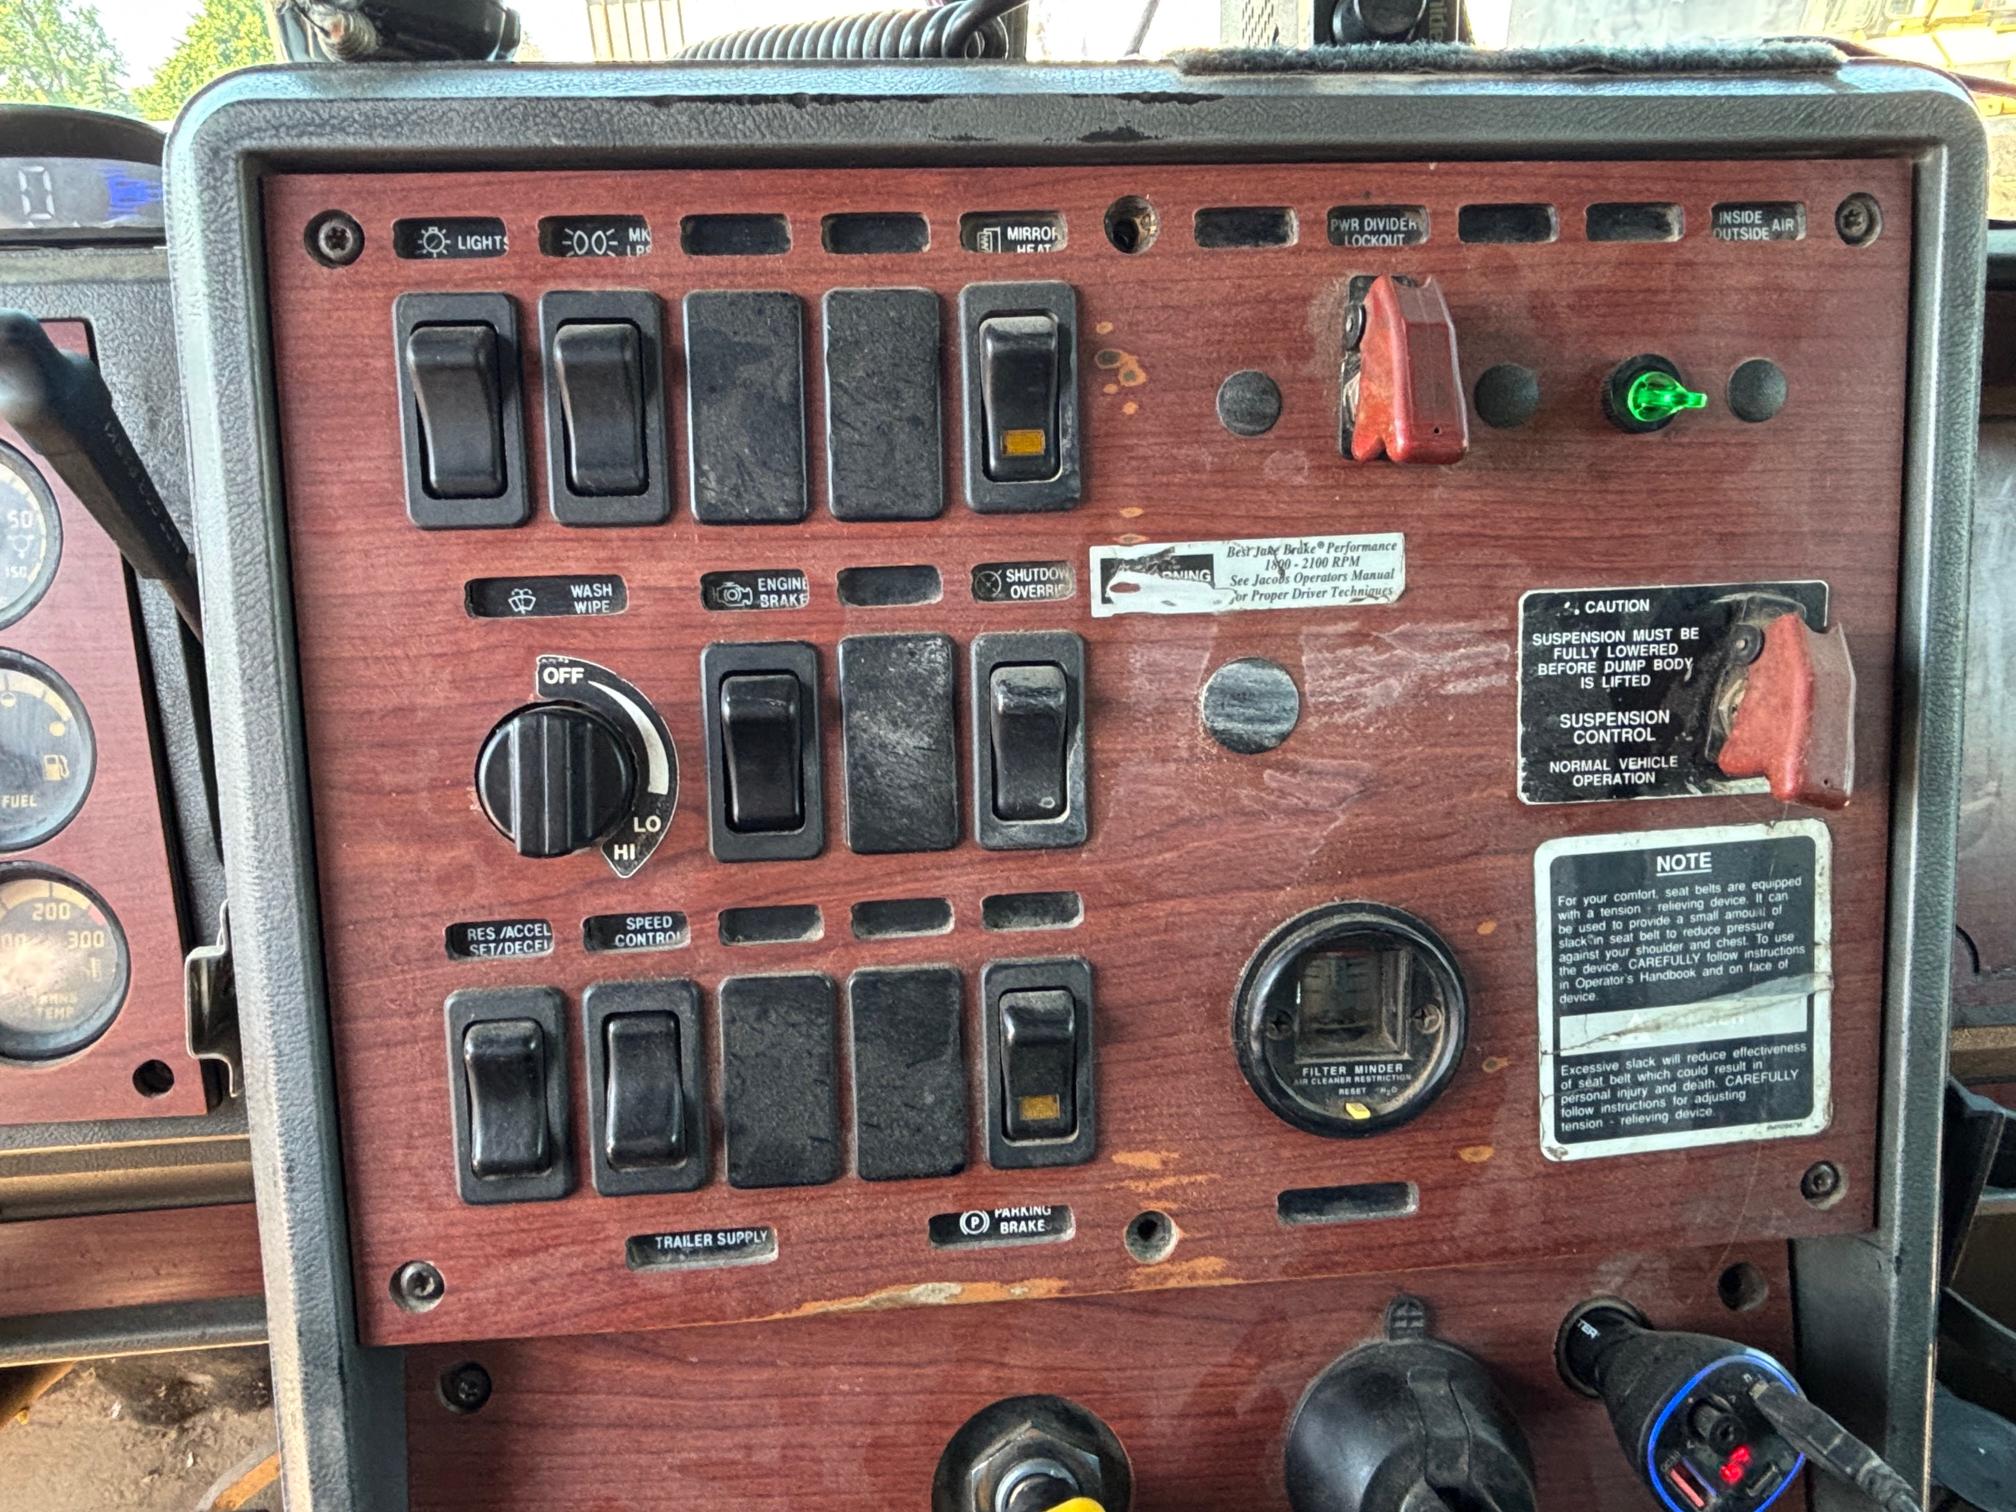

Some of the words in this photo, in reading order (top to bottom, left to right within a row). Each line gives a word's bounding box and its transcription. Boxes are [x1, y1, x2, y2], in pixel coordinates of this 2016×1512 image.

[1330, 218, 1359, 231] PWR
[1364, 218, 1416, 231] DIVIDER
[1720, 211, 1762, 224] INSIDE
[1772, 218, 1794, 231] AIR
[1345, 234, 1405, 246] LOCKOUT
[1713, 228, 1769, 240] OUTSIDE
[1227, 547, 1250, 558] Best
[1327, 542, 1397, 554] Performance
[1265, 558, 1291, 571] 1800
[1302, 557, 1328, 569] 2100
[1332, 556, 1360, 568] RPM
[758, 577, 808, 591] ENGINE
[1230, 574, 1250, 587] See
[1252, 574, 1290, 587] Jacobs
[1294, 572, 1347, 586] Operators
[1352, 568, 1395, 580] Manual
[571, 584, 612, 598] WASH
[1252, 589, 1289, 604] Proper
[1292, 587, 1327, 599] Driver
[574, 600, 610, 614] WIPE
[760, 593, 808, 608] BRAKE
[1585, 599, 1650, 614] CAUTION
[1532, 630, 1625, 646] SUSPENSION
[1633, 628, 1673, 642] MUST
[1680, 627, 1699, 640] BE
[1554, 647, 1599, 660] FULLY
[1607, 643, 1678, 658] LOWERED
[1538, 662, 1596, 675] BEFORE
[1604, 660, 1646, 673] DUMP
[1653, 657, 1693, 671] BODY
[542, 667, 584, 684] OFF
[1581, 677, 1594, 689] IS
[1602, 674, 1651, 688] LIFTED
[1560, 710, 1670, 728] SUSPENSION
[1573, 727, 1656, 744] CONTROL
[1550, 759, 1610, 773] NORMAL
[1619, 756, 1678, 770] VEHICLE
[1573, 772, 1656, 787] OPERATION
[2, 794, 37, 807] FUEL
[634, 816, 661, 833] LO
[614, 844, 636, 860] HI
[1656, 852, 1712, 872] NOTE
[1557, 896, 1578, 907] For
[1582, 894, 1608, 908] your
[1664, 886, 1690, 898] seat
[1694, 883, 1722, 895] belts
[1727, 882, 1746, 893] are
[1751, 876, 1802, 891] equipped
[32, 902, 71, 921] 200
[1557, 909, 1581, 921] with
[1586, 909, 1595, 919] a
[1600, 905, 1642, 918] tension
[1657, 899, 1705, 912] relieving
[1710, 896, 1749, 908] device.
[1755, 892, 1763, 904] It
[1768, 892, 1790, 903] can
[626, 916, 672, 930] SPEED
[1558, 923, 1574, 935] be
[1578, 920, 1607, 933] used
[1612, 920, 1624, 931] to
[1628, 915, 1672, 931] provide
[1676, 915, 1684, 925] a
[1690, 910, 1719, 923] small
[1771, 904, 1783, 917] of
[68, 930, 105, 949] 300
[467, 927, 496, 941] RES
[615, 932, 680, 947] CONTROL
[1558, 936, 1587, 950] slack
[1593, 935, 1604, 946] in
[1609, 932, 1634, 945] seat
[1639, 929, 1660, 942] belt
[1666, 929, 1678, 939] to
[1682, 925, 1722, 937] reduce
[1726, 920, 1775, 936] pressure
[1558, 949, 1600, 964] against
[1604, 947, 1631, 961] your
[1635, 942, 1684, 956] shoulder
[1688, 938, 1711, 951] and
[1715, 936, 1750, 948] chest.
[1755, 933, 1770, 945] To
[1774, 932, 1795, 943] use
[1558, 966, 1577, 977] the
[1582, 962, 1623, 975] device.
[1628, 952, 1701, 970] CAREFULLY
[1706, 951, 1739, 963] follow
[1744, 945, 1806, 959] instructions
[1559, 981, 1570, 990] in
[1574, 974, 1634, 990] Operator's
[1640, 968, 1697, 983] Handbook
[1702, 964, 1724, 977] and
[1728, 964, 1744, 975] on
[1748, 961, 1773, 973] face
[1777, 958, 1789, 970] of
[1559, 992, 1600, 1006] device.
[1560, 1061, 1620, 1077] Excessive
[1625, 1056, 1656, 1070] slack
[1661, 1053, 1681, 1066] will
[1686, 1050, 1727, 1064] reduce
[1732, 1042, 1808, 1059] effectiveness
[1302, 1066, 1346, 1076] FILTER
[1354, 1063, 1403, 1074] MINDER
[1560, 1078, 1572, 1090] of
[1578, 1076, 1604, 1088] seat
[1609, 1073, 1632, 1086] belt
[1636, 1068, 1672, 1082] which
[1676, 1064, 1709, 1078] could
[1714, 1061, 1747, 1075] result
[1752, 1060, 1763, 1070] in
[1311, 1076, 1351, 1085] CLEANER
[1354, 1074, 1411, 1083] RESTRICTION
[1560, 1088, 1612, 1106] personal
[1616, 1086, 1649, 1100] injury
[1654, 1082, 1677, 1095] and
[1724, 1069, 1800, 1087] CAREFULLY
[1339, 1087, 1366, 1095] RESET
[1560, 1106, 1595, 1118] follow
[1600, 1098, 1667, 1114] instructions
[1672, 1095, 1689, 1106] for
[1694, 1090, 1747, 1105] adjusting
[1560, 1118, 1604, 1133] tension
[1620, 1112, 1670, 1127] relieving
[1674, 1107, 1716, 1121] device.
[994, 1206, 1051, 1218] PARKING
[1001, 1220, 1045, 1234] BRAKE
[655, 1233, 712, 1249] TRAILER
[717, 1231, 768, 1245] SUPPLY
